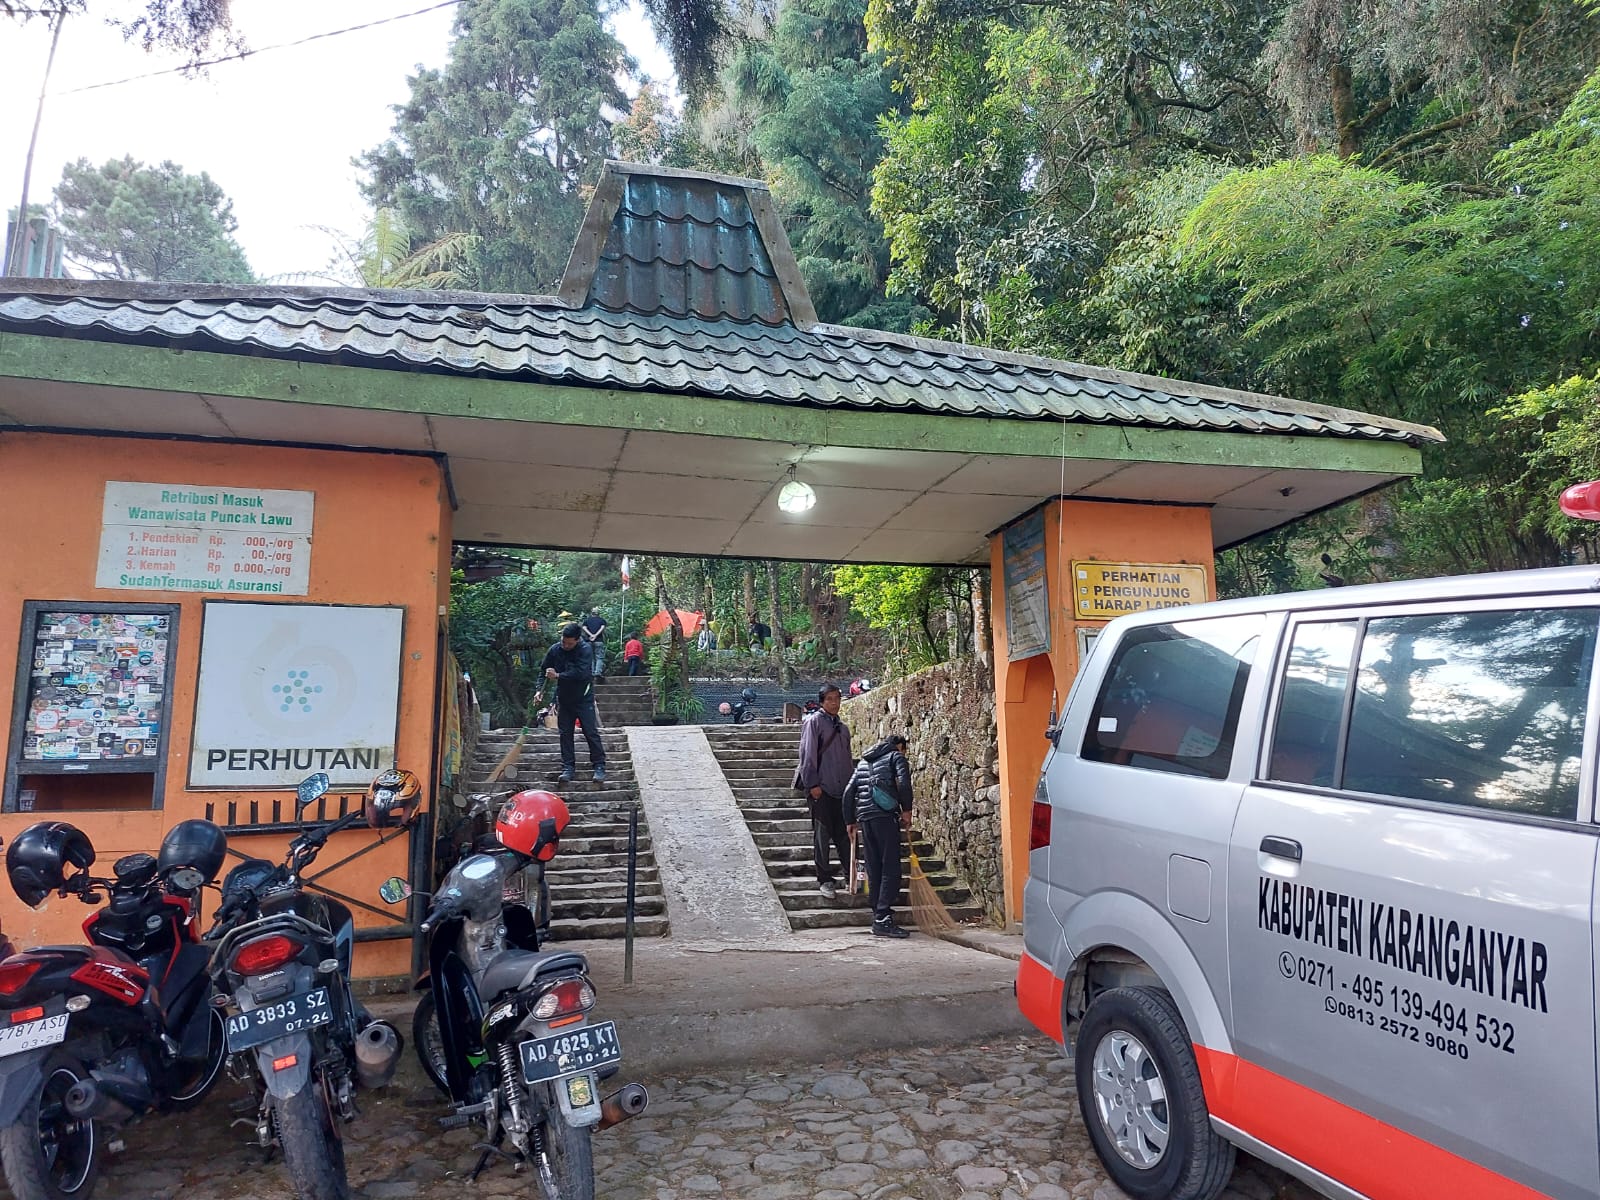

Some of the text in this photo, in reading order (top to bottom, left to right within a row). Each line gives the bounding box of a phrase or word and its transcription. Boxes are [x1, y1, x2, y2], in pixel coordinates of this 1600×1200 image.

[161, 490, 264, 508] Retribusi Masuk
[128, 506, 293, 526] Wanawisata Puncak Lawu
[129, 531, 138, 542] 1.
[142, 532, 199, 544] Pendakian
[209, 535, 226, 547] Rp.
[140, 546, 177, 557] Harian
[208, 549, 225, 560] Rp.
[139, 560, 176, 571] Kemah
[227, 578, 283, 593] Asuransi
[1102, 571, 1181, 584] PERHATIAN
[1093, 586, 1191, 599] PENGUNJUNG
[1094, 599, 1142, 611] HARAP
[207, 748, 380, 771] PERHUTANI
[1258, 876, 1549, 1013] KABUPATEN KARANGANYAR
[258, 969, 286, 981] HONDA
[228, 990, 327, 1035] AD 3833 SZ
[1298, 956, 1334, 991] 0271
[1352, 973, 1384, 1007] 495
[1476, 1013, 1515, 1054] 532
[38, 1014, 68, 1033] ASD
[1338, 1001, 1469, 1060] 0813 2572 9080
[528, 1043, 547, 1063] AD
[595, 1026, 614, 1045] KT
